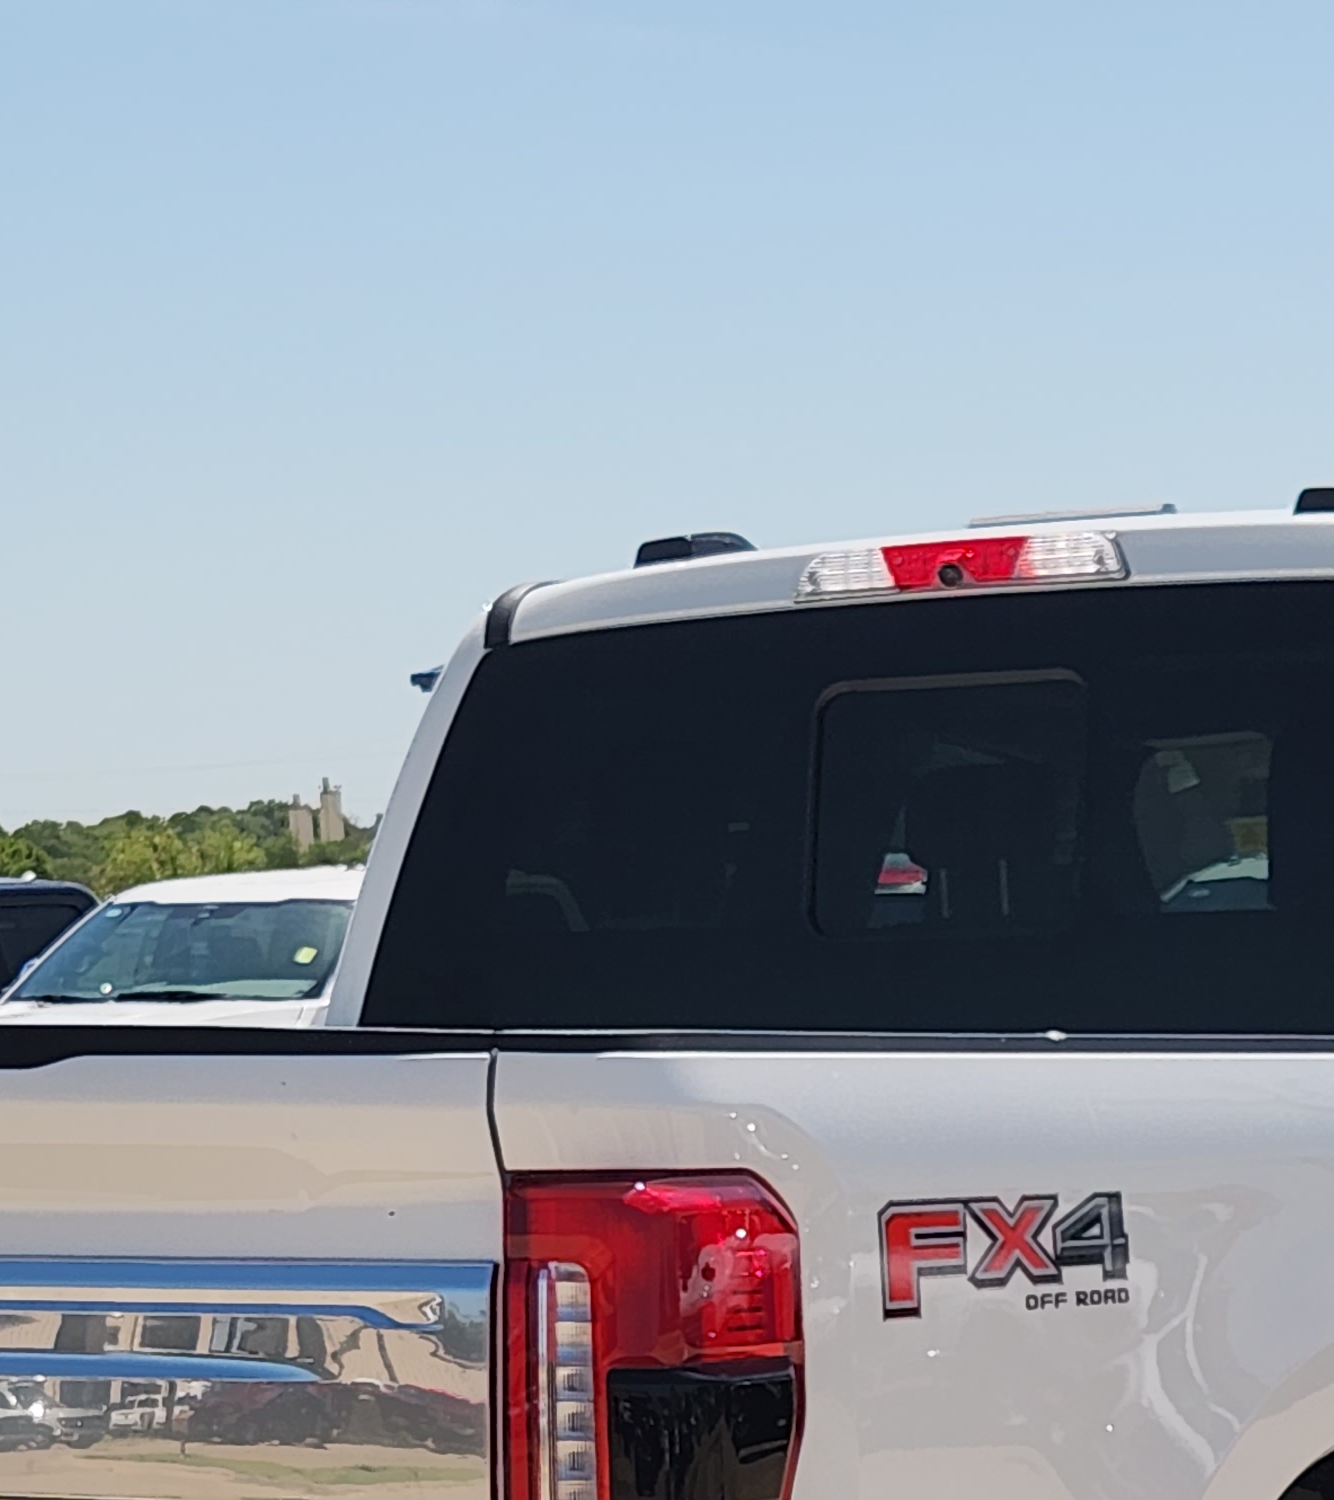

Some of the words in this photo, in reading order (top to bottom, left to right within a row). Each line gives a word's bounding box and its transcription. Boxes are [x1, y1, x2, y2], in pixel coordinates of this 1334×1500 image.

[878, 1191, 1130, 1321] FX4
[1025, 1292, 1068, 1311] OFF
[1076, 1287, 1130, 1307] ROAD
